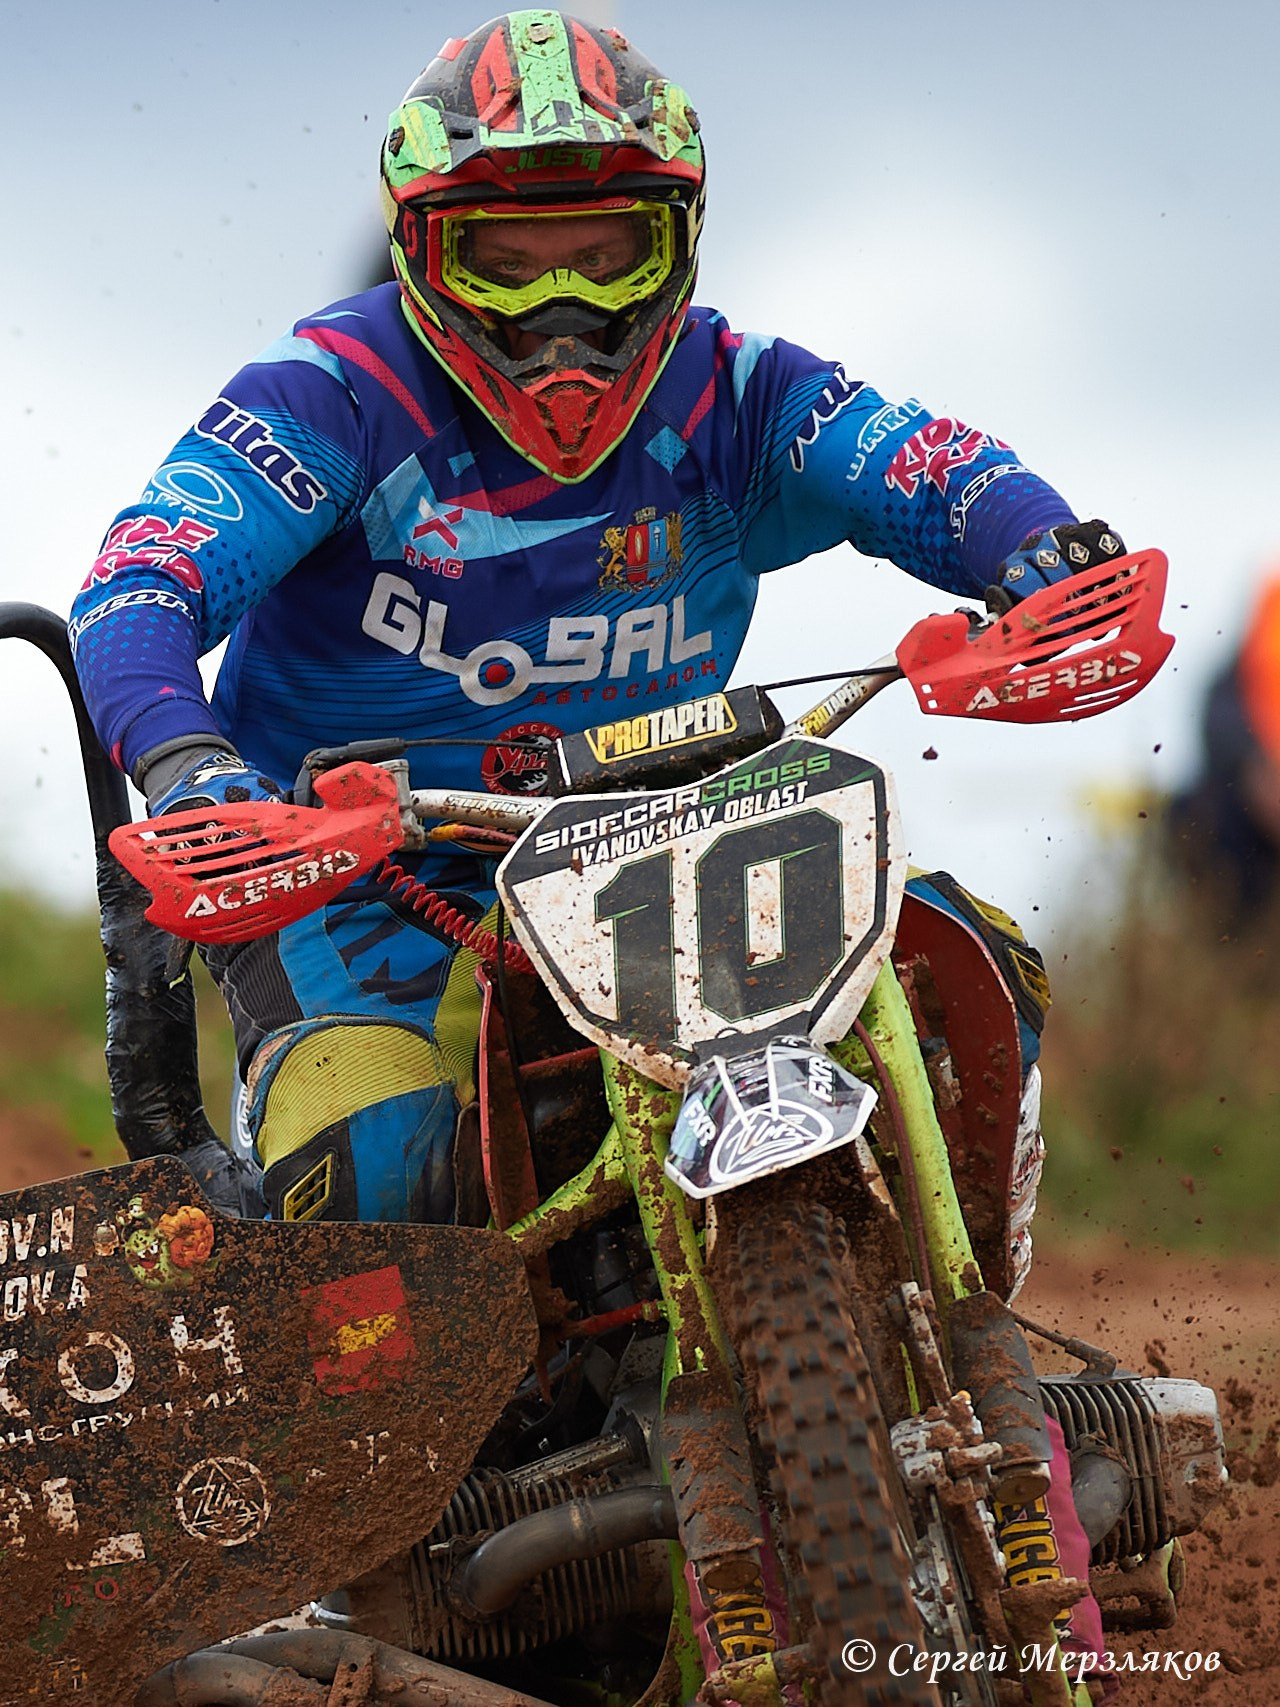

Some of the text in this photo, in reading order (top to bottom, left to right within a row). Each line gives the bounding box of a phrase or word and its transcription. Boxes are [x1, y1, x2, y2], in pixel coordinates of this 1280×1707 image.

[504, 148, 602, 173] JUST1
[403, 544, 465, 580] RMG
[361, 571, 712, 707] GLOBAL
[533, 659, 718, 706] АВТОСАЛОН
[596, 696, 727, 756] PROTAPER
[572, 804, 720, 868] IVANOVSKAY
[723, 781, 809, 824] OBLAST
[594, 806, 847, 1046] 10
[808, 1056, 835, 1103] FXR
[683, 1099, 718, 1148] FXR
